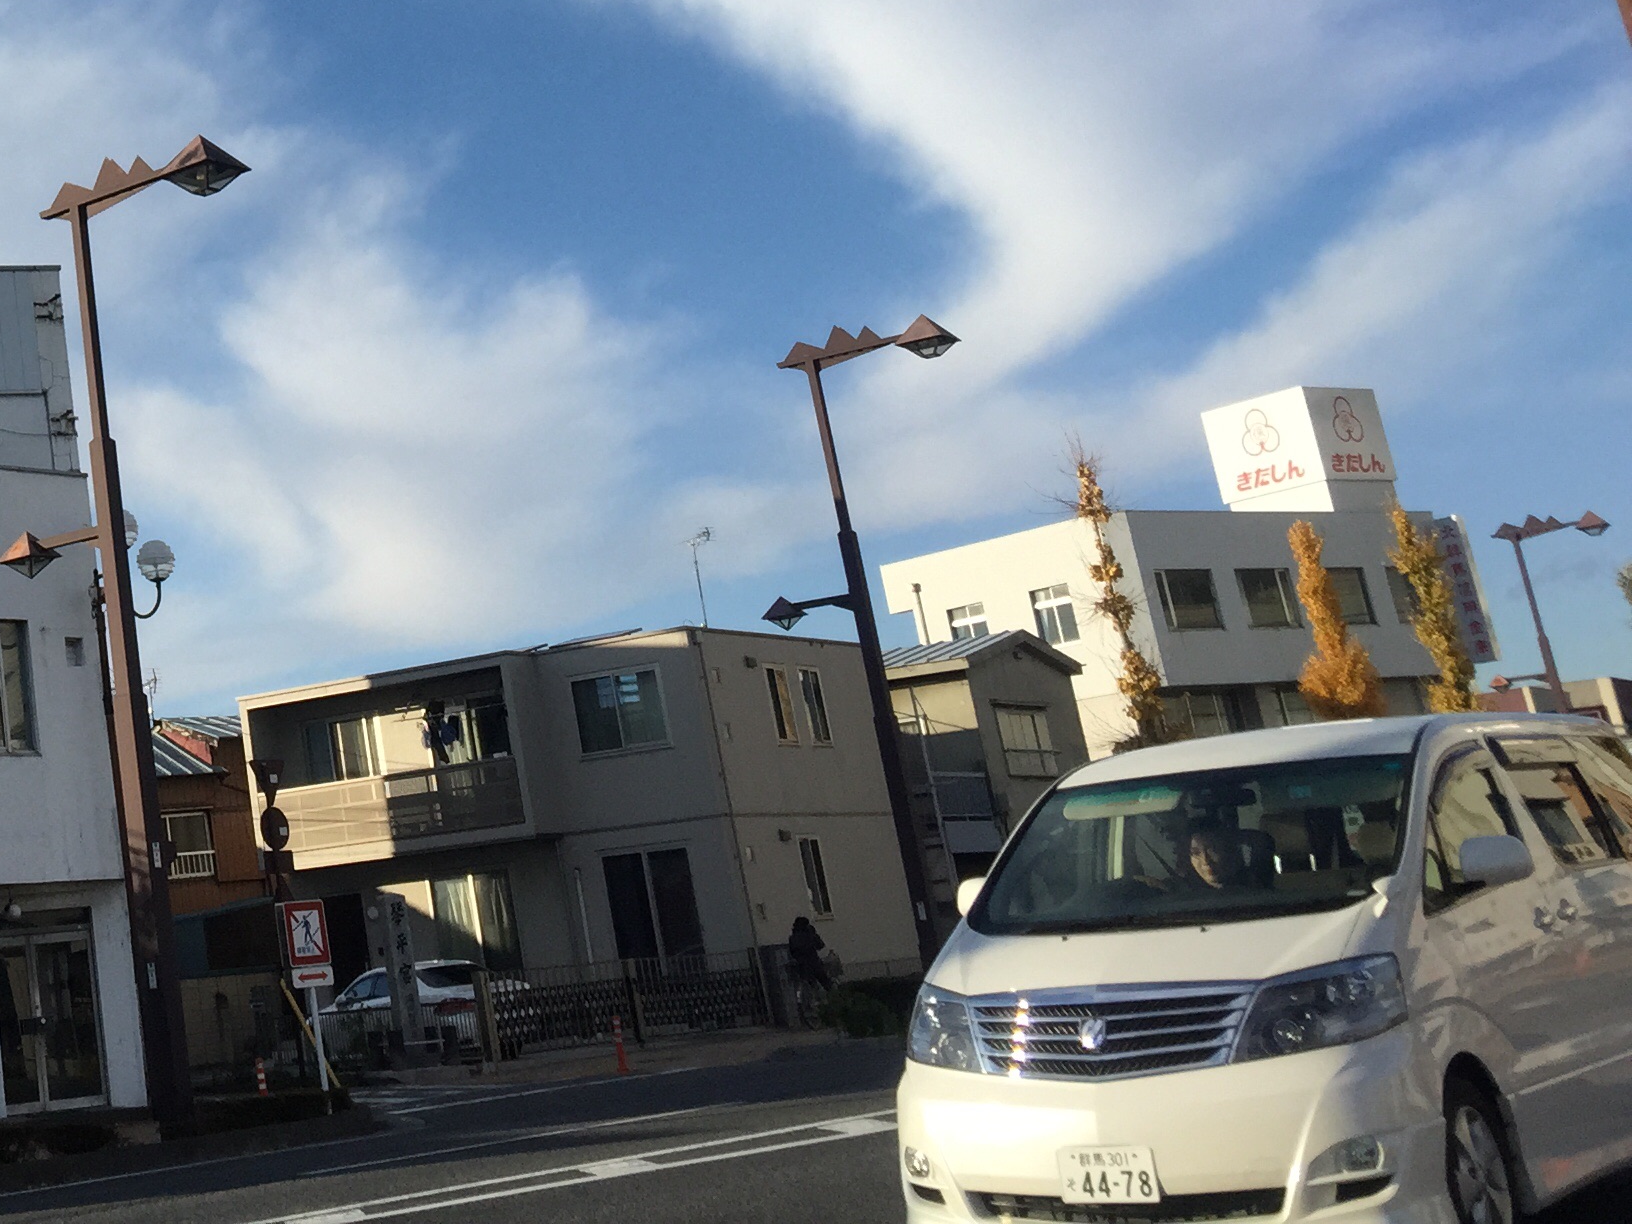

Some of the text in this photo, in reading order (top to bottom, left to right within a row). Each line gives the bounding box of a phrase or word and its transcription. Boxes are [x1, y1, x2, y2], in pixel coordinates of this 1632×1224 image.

[1236, 460, 1306, 492] きたしん
[1331, 452, 1386, 474] きたしん
[1082, 1170, 1153, 1198] 44-78
